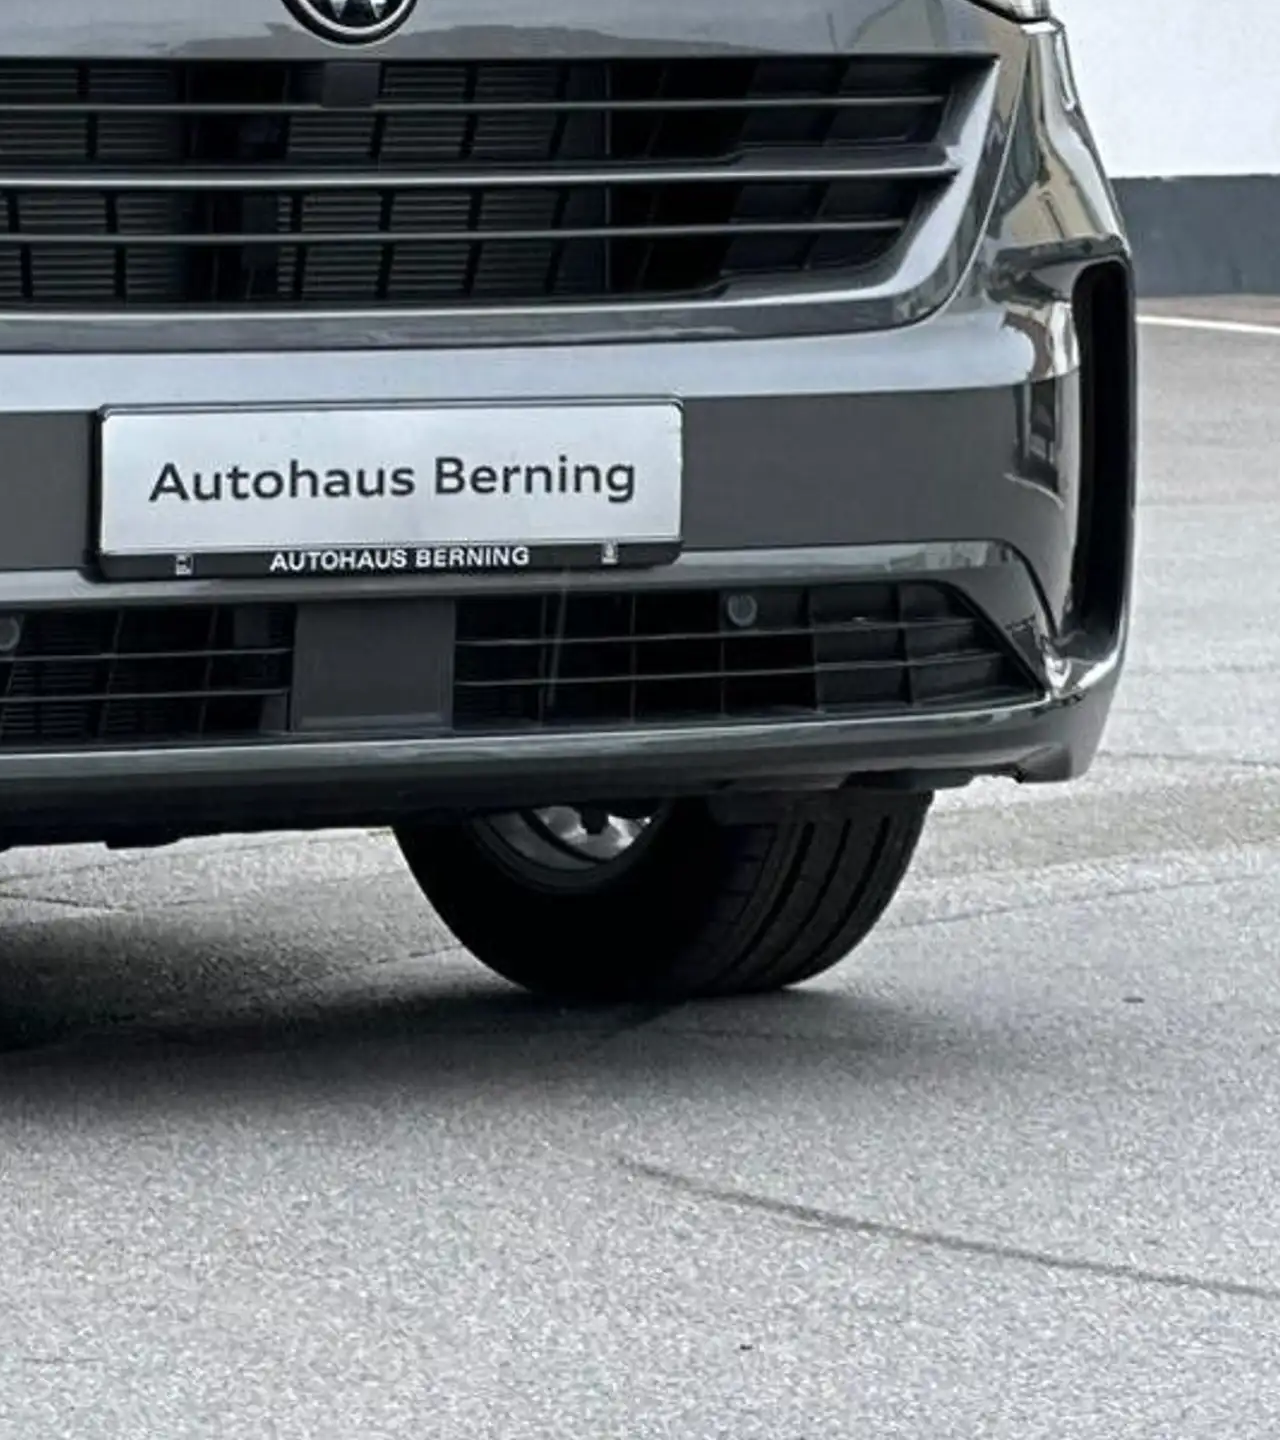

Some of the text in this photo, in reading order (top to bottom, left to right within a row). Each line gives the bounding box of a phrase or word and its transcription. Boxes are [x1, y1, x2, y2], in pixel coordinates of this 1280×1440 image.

[148, 453, 636, 504] Autohaus Berning
[269, 545, 530, 573] AUTOHAUS BERNING
